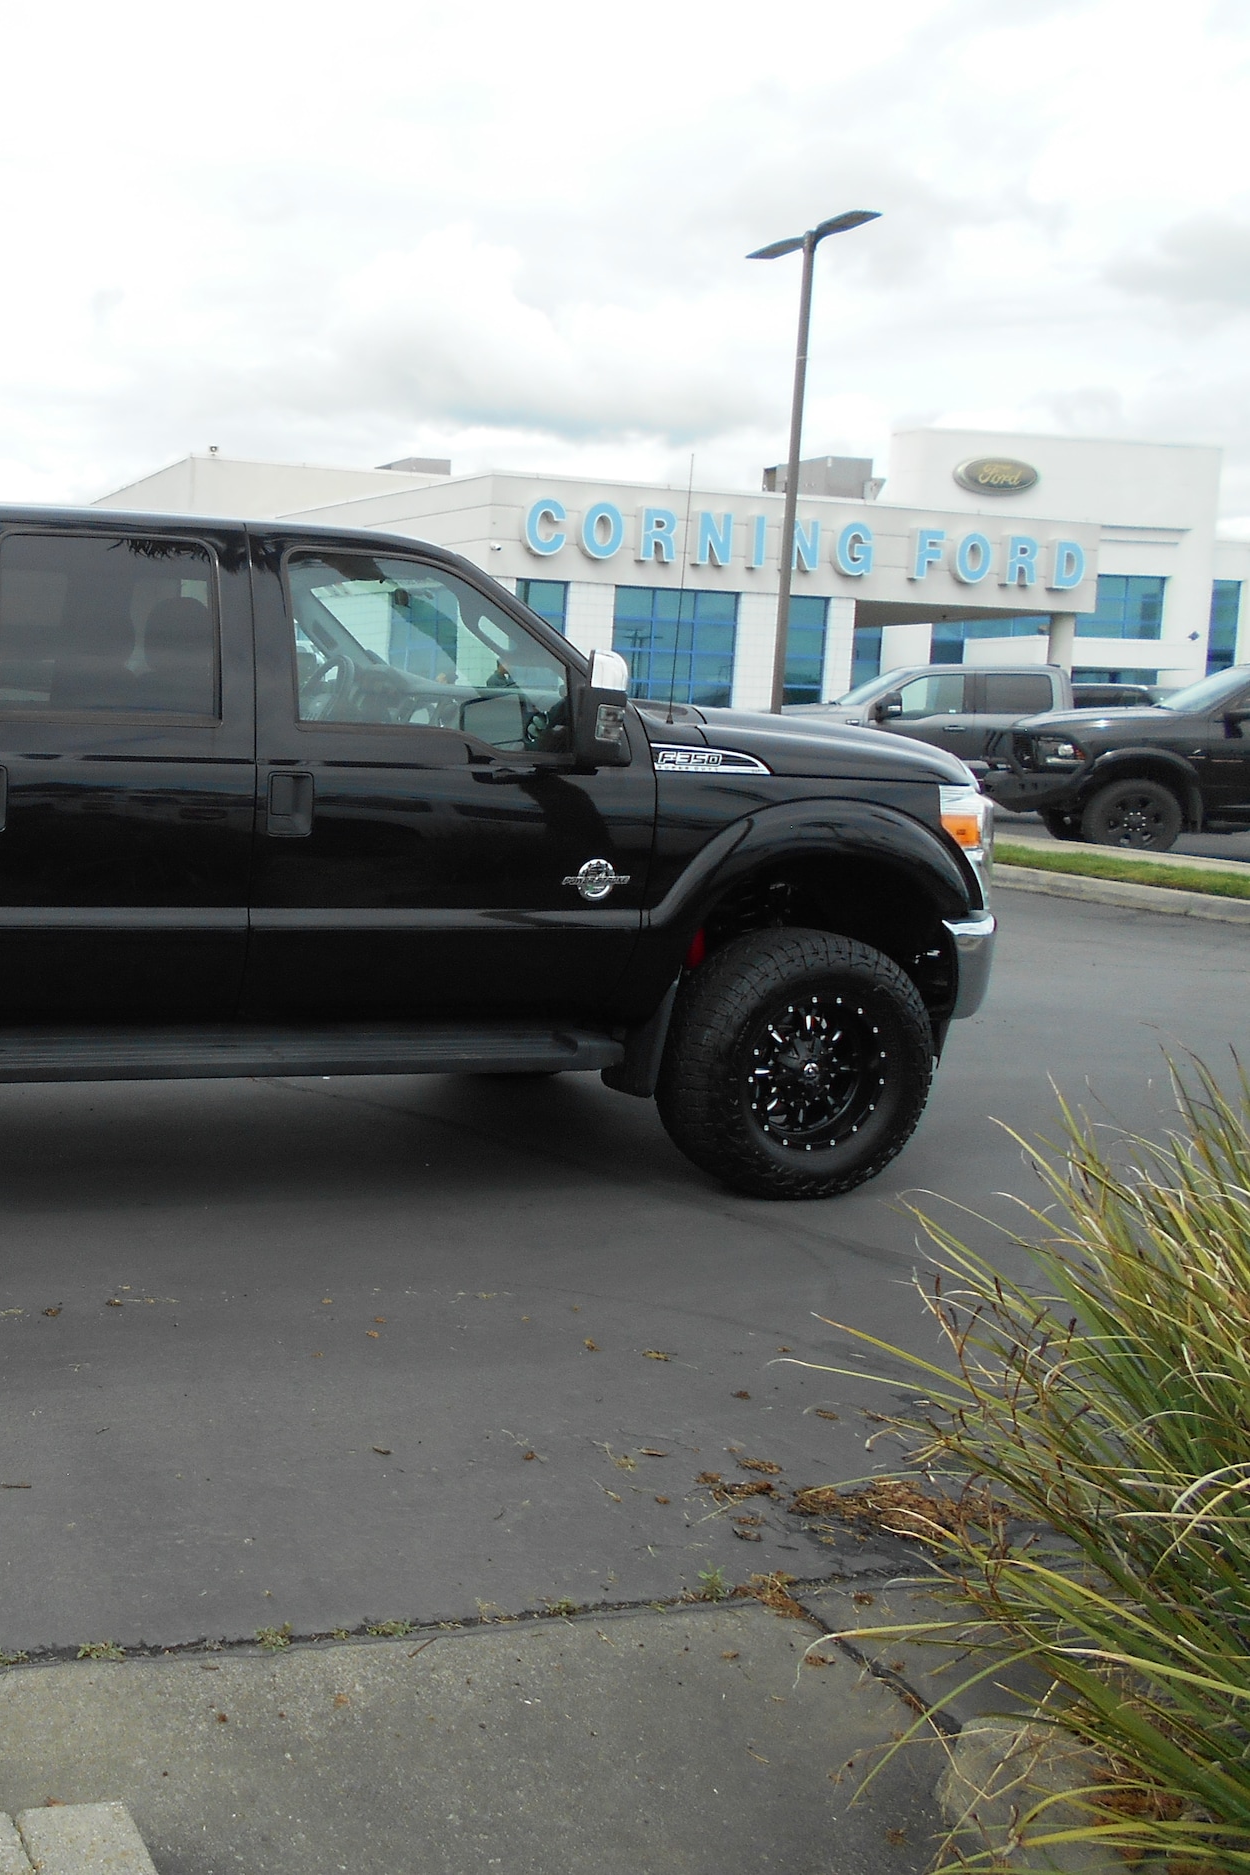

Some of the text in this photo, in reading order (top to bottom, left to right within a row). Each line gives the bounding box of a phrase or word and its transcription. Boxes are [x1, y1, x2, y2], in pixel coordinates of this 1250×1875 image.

[979, 464, 1023, 485] Ford
[523, 497, 1086, 590] CORNING FORD
